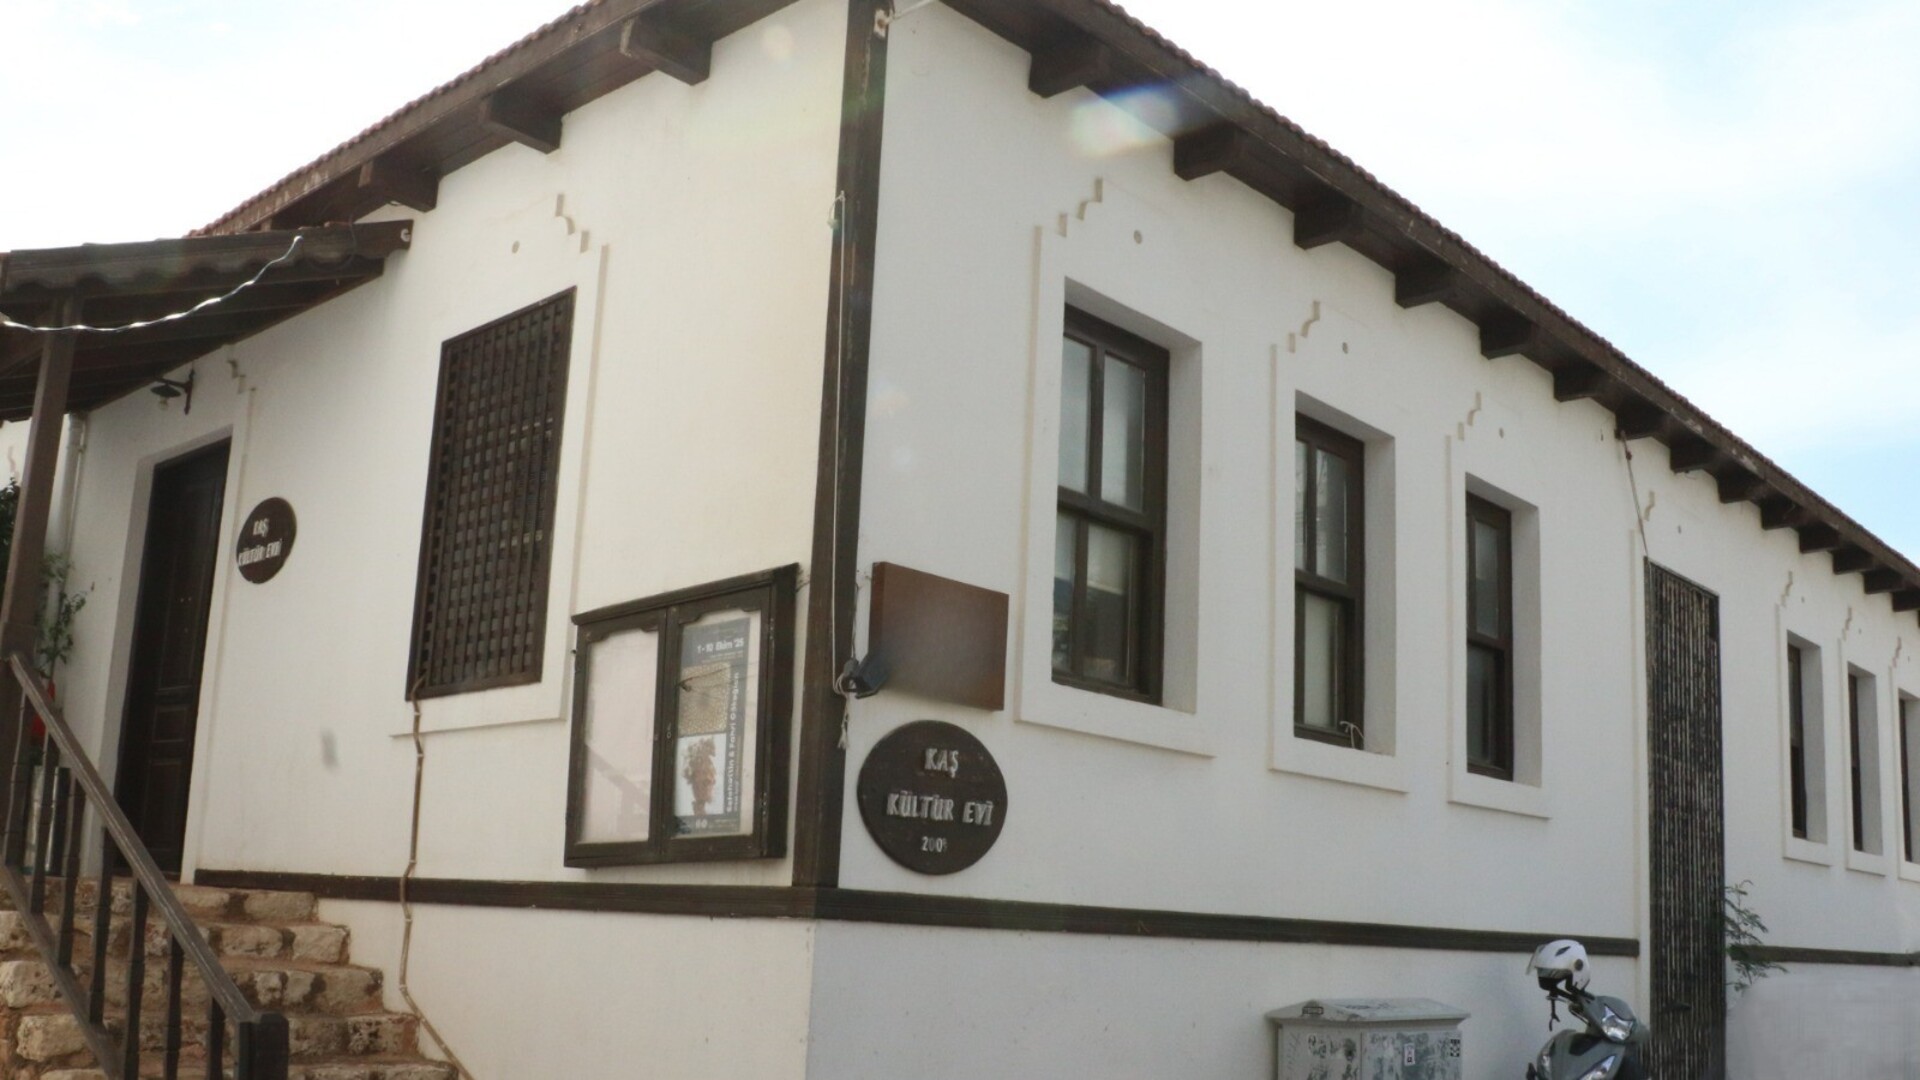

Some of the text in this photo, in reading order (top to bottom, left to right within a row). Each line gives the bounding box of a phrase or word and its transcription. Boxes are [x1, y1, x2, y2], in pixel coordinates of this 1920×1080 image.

[924, 748, 959, 778] KAŞ
[886, 791, 995, 826] KÜLTÜR EVİ
